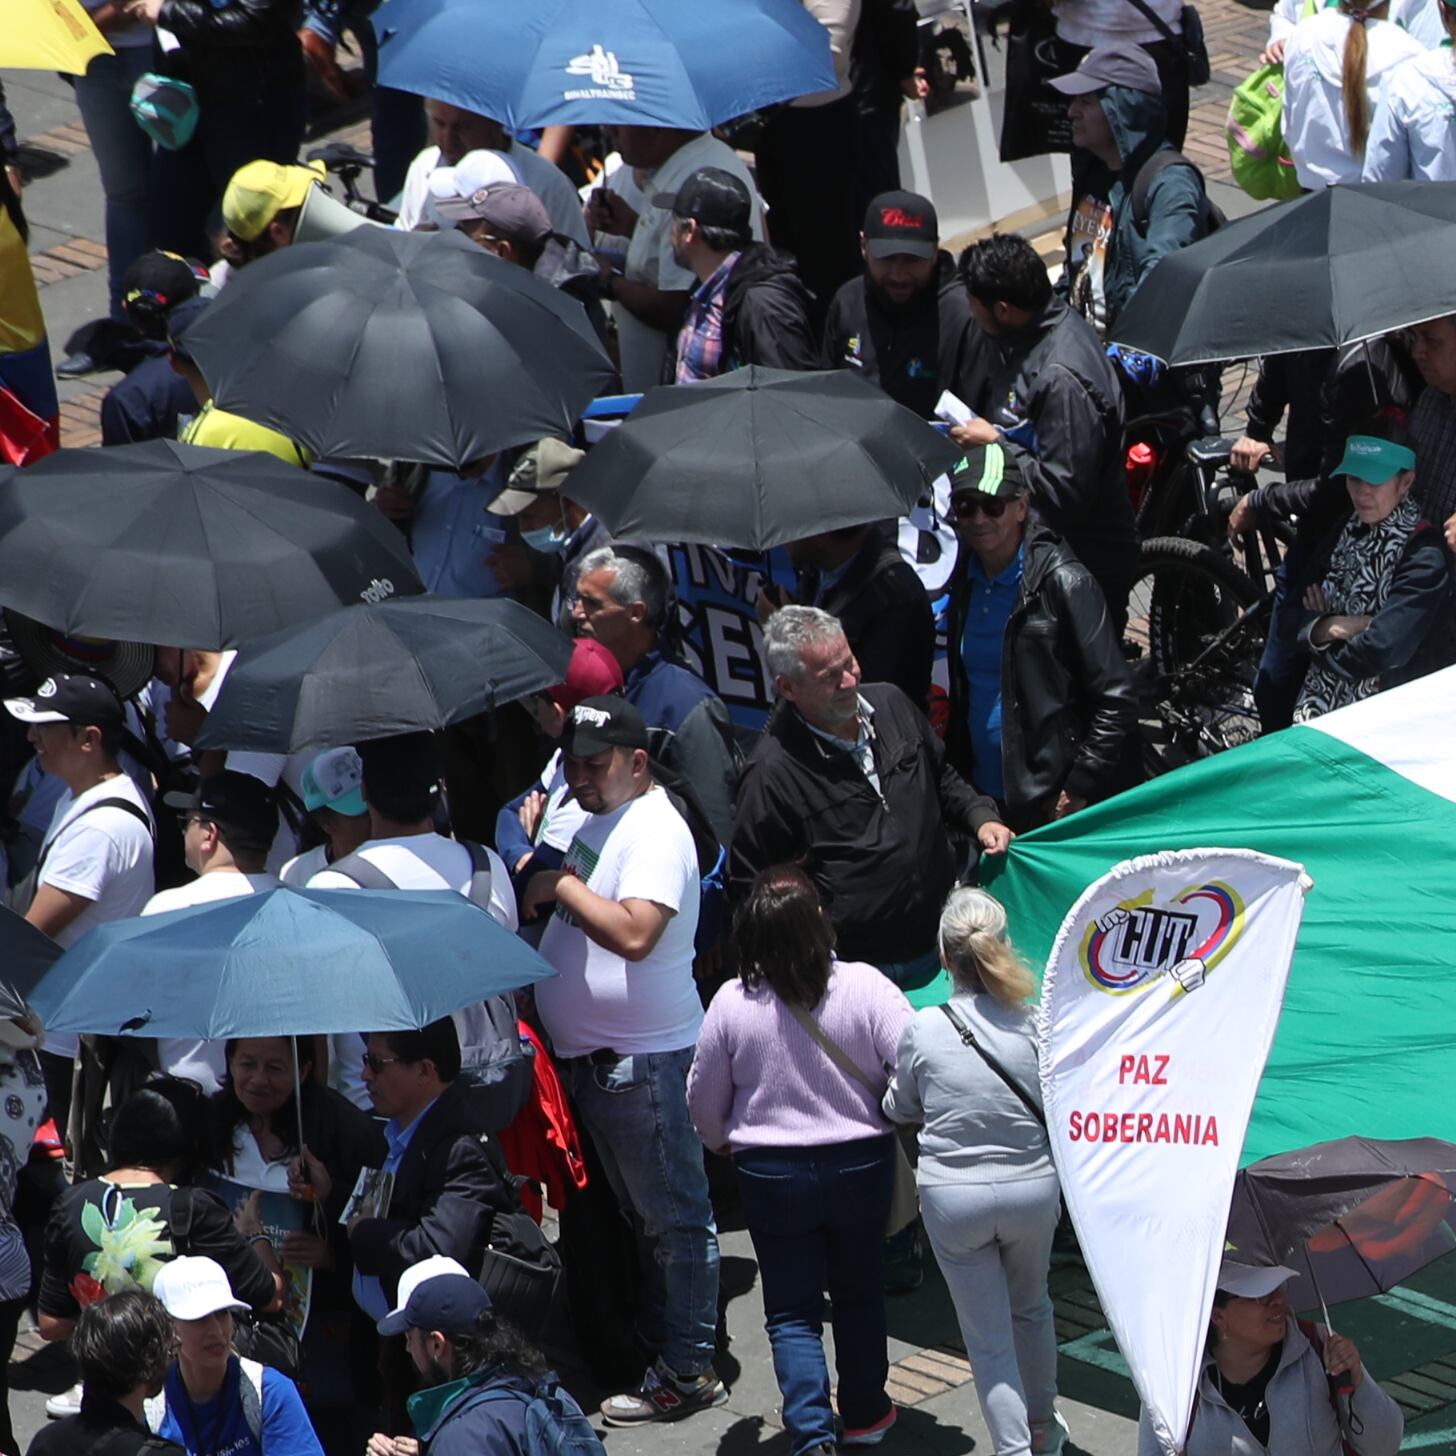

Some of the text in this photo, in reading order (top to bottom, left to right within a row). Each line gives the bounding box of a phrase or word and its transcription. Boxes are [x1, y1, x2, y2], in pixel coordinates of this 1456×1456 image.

[1112, 906, 1199, 971] CUT
[1118, 1054, 1171, 1085] PAZ
[1068, 1110, 1220, 1147] SOBERANIA
